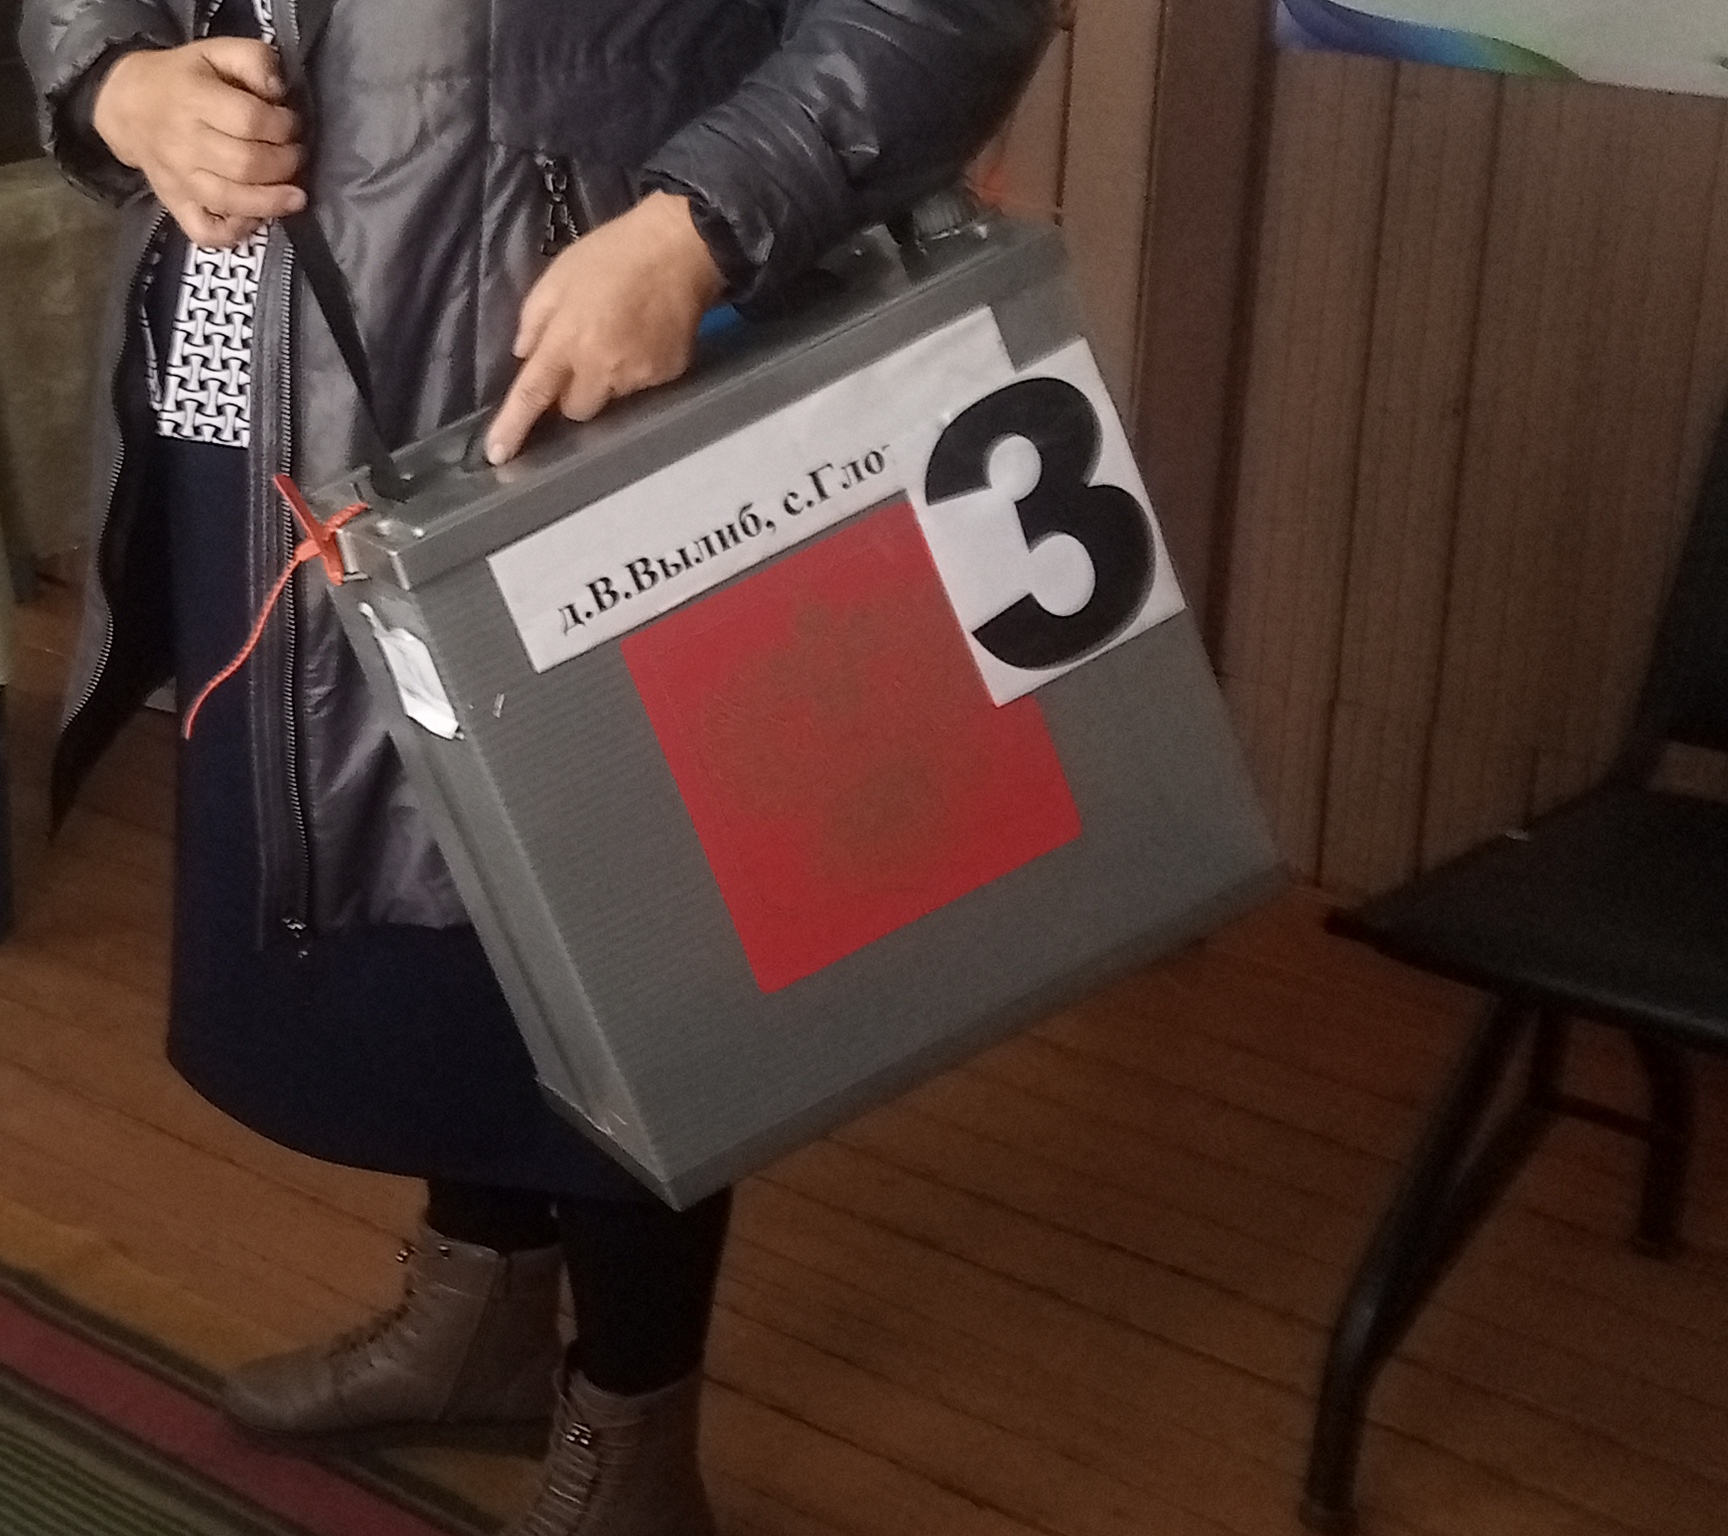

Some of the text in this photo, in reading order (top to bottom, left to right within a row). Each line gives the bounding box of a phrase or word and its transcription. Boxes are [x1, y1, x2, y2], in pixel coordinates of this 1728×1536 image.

[556, 442, 896, 632] д.В.Вылиб, с.Гло
[925, 376, 1152, 671] 3
